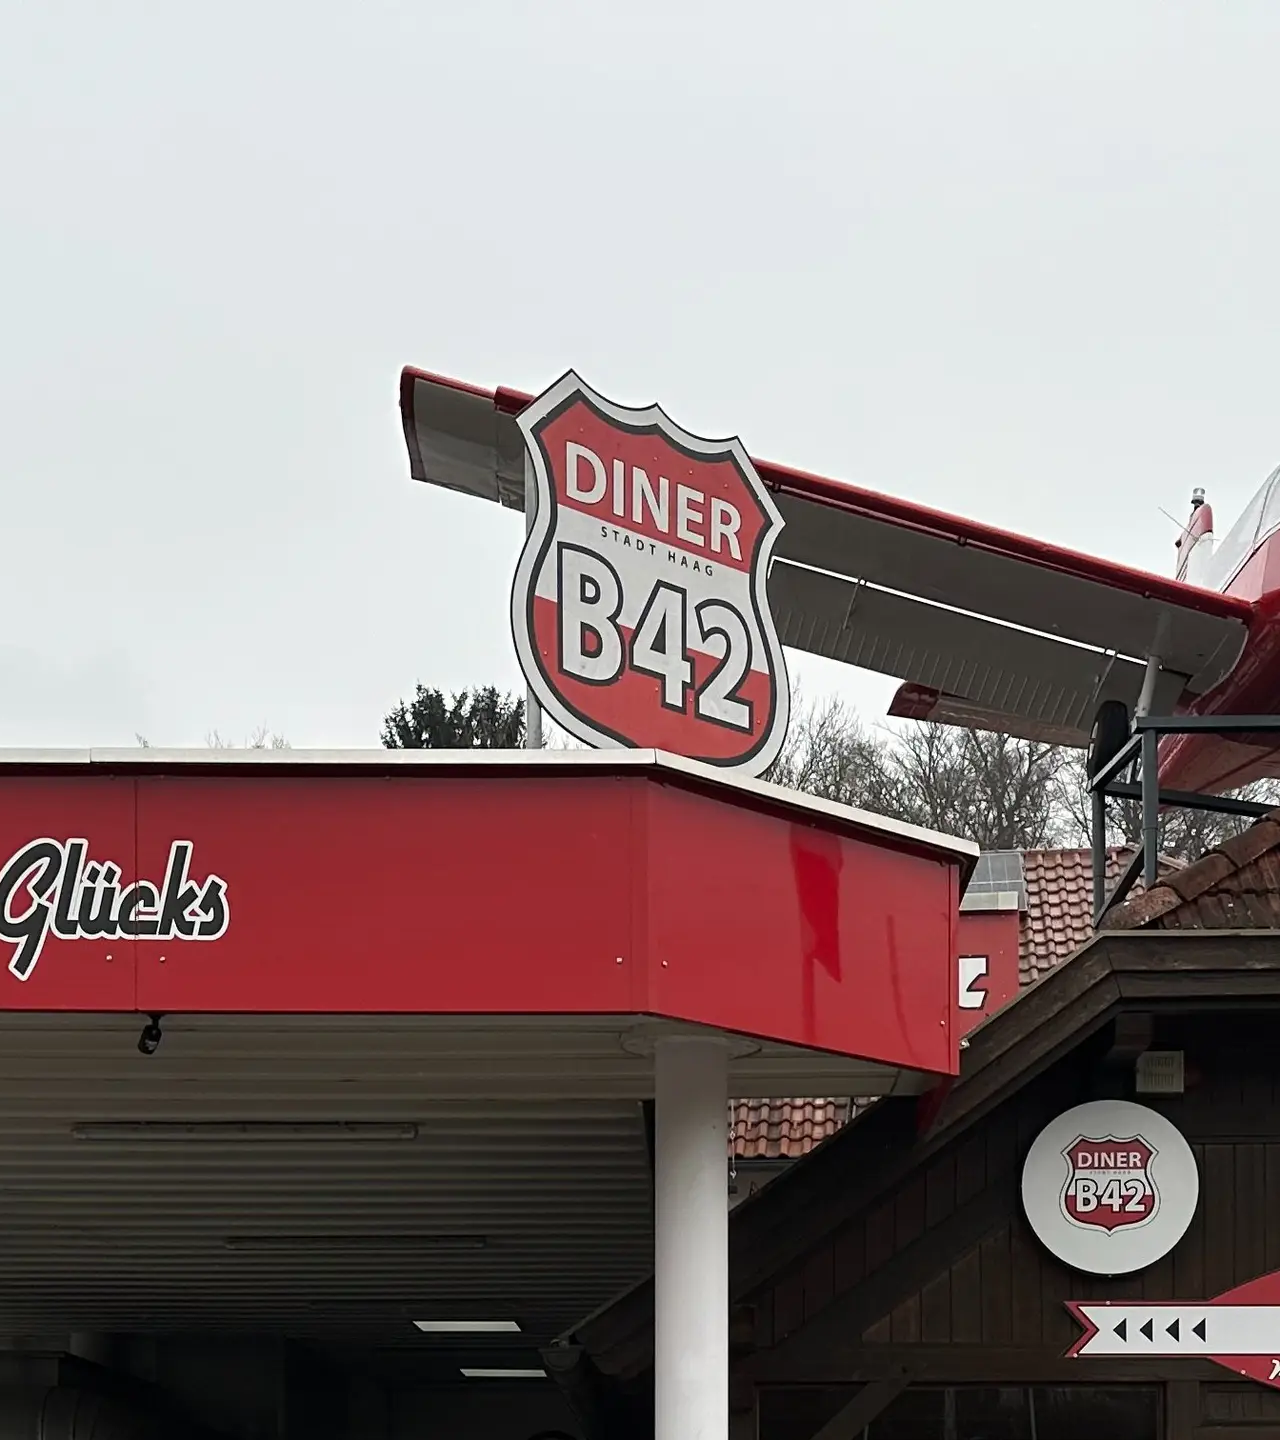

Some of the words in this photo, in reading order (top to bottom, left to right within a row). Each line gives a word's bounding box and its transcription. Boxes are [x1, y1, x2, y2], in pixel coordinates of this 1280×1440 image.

[564, 440, 743, 562] DINER
[600, 525, 657, 556] STADT
[667, 550, 714, 578] HAAG
[557, 540, 754, 735] B42
[1077, 1151, 1143, 1168] DINER
[1074, 1178, 1147, 1214] B42
